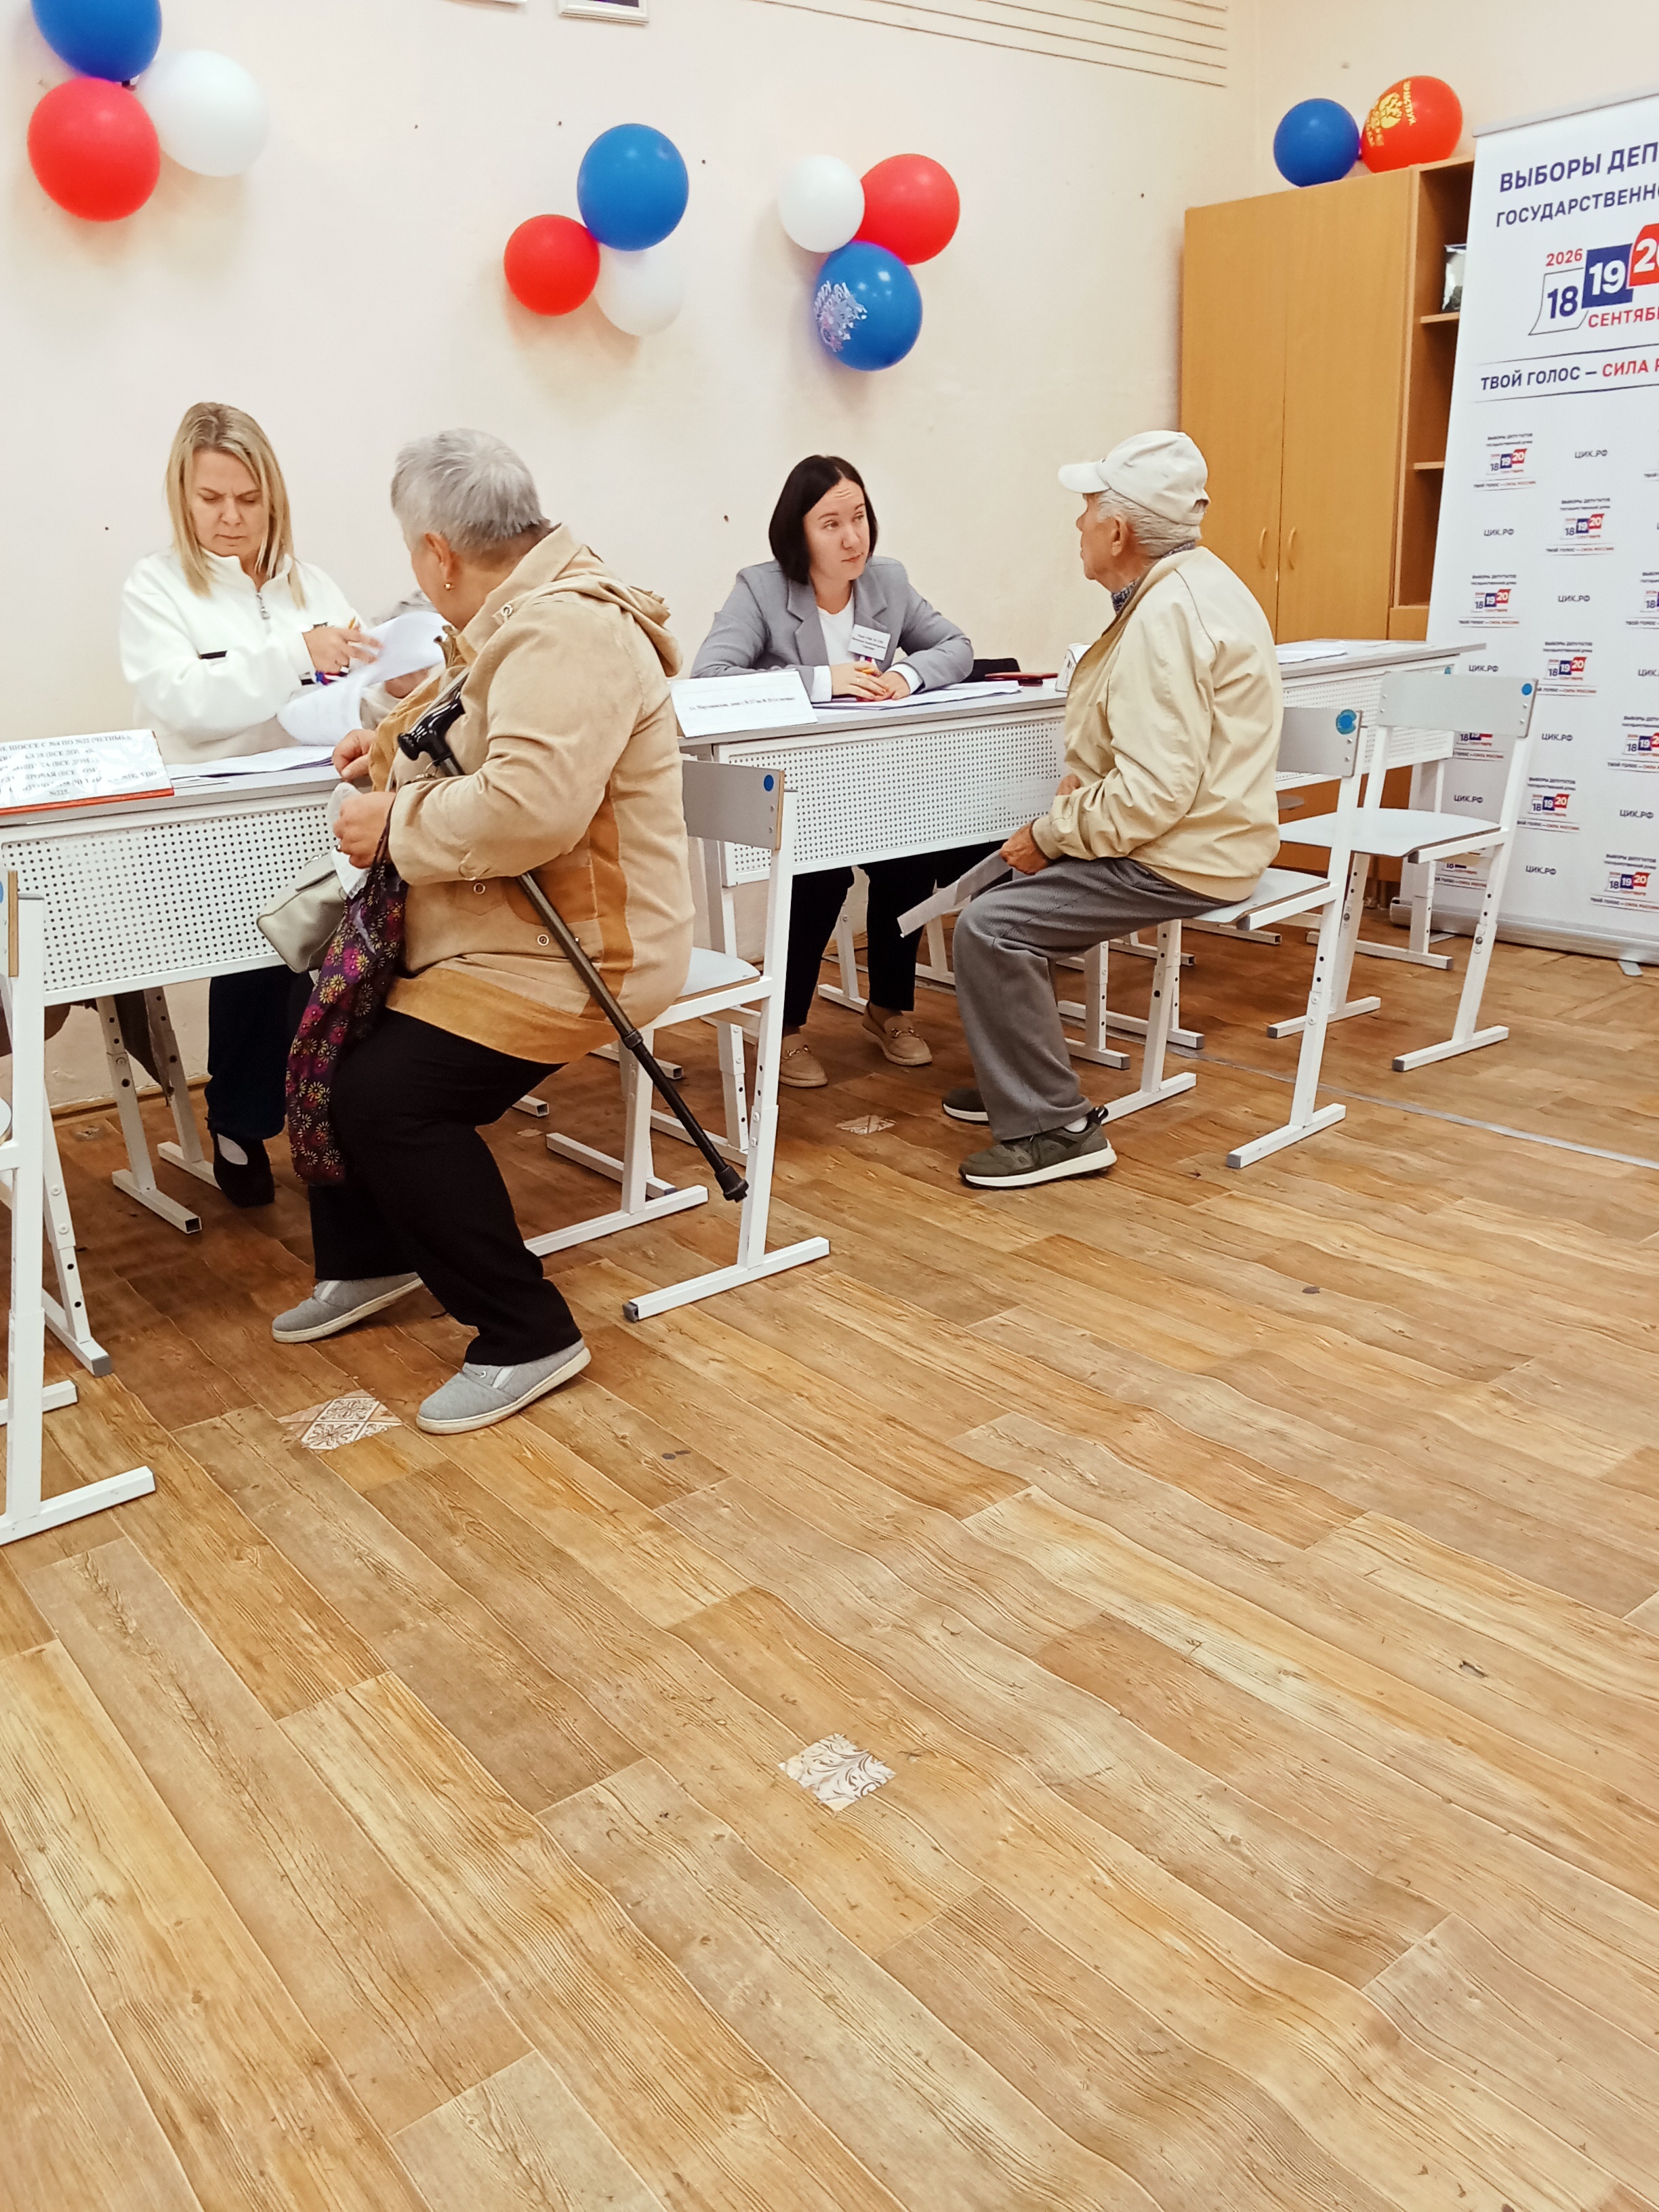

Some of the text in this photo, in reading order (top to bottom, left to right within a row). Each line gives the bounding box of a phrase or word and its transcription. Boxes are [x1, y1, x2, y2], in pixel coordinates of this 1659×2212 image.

[1500, 153, 1601, 192] ВЫБОРЫ
[1496, 183, 1659, 228] ГОСУДАРСТВЕНН
[1546, 248, 1582, 266] 2026
[1547, 238, 1659, 319] 18 19 2
[1588, 307, 1659, 328] СЕНТЯБ
[1481, 370, 1522, 390] ТВОЙ
[1527, 367, 1580, 386] ГОЛОС
[1602, 360, 1648, 377] СИЛА
[1574, 449, 1607, 459] ЦИК.РФ
[1484, 529, 1514, 537] ЦИК.РФ
[1542, 733, 1573, 741] ЦИК.РФ
[1454, 794, 1483, 804] ЦИК.РФ
[1532, 797, 1568, 811] 18 19 20
[1619, 809, 1654, 819] ЦИК.РФ
[1525, 865, 1557, 875] ЦИК.РФ
[1610, 875, 1647, 889] 18 19 20
